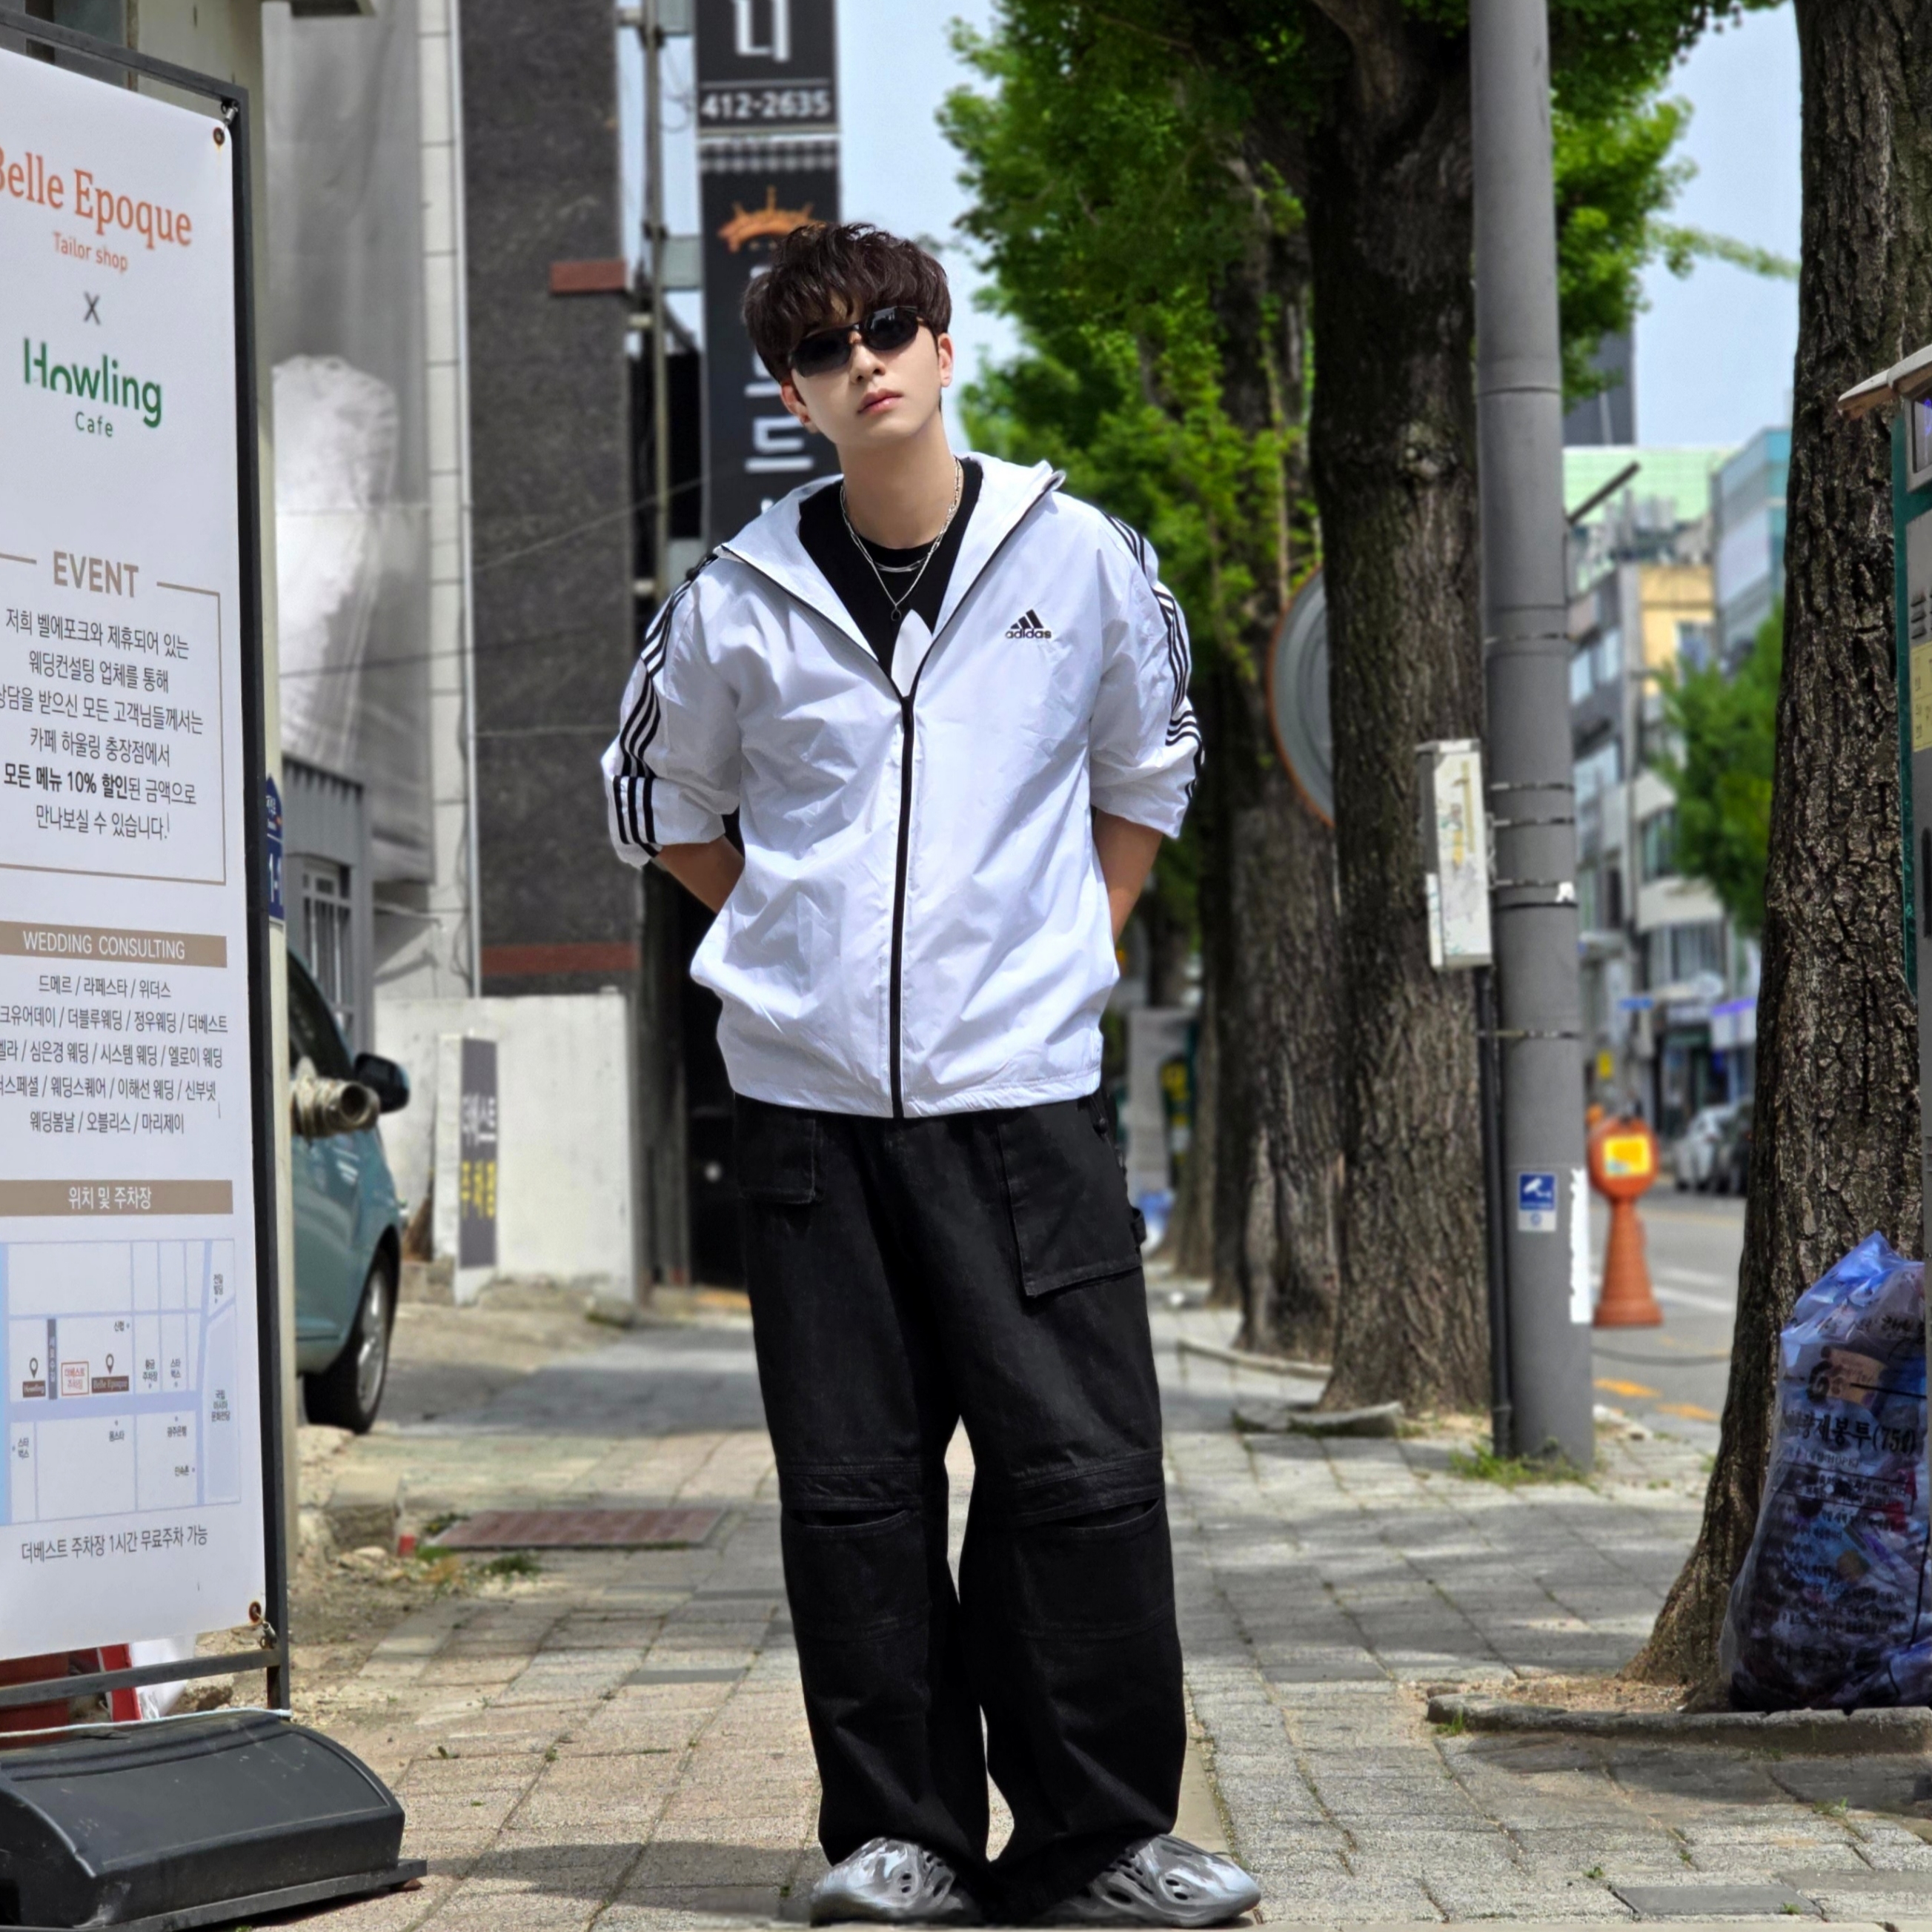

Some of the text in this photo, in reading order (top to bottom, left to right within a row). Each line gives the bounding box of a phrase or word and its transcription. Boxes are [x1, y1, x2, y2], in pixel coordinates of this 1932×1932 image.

[73, 168, 193, 249] Epoque
[53, 232, 128, 274] Tailor shop
[23, 338, 162, 428] Howling
[76, 412, 113, 437] Cafe
[53, 551, 139, 597] EVENT
[6, 608, 189, 660] 저희 벨에포크와 제휴되어 있는
[1005, 628, 1052, 639] adidas
[29, 650, 169, 693] 웨딩컨설팅 업체를 통해
[39, 690, 78, 718] 받으신
[83, 697, 109, 722] 모든
[113, 701, 204, 734] 고객님들께서는
[30, 728, 169, 767] 카페 하울링 충장점에서
[4, 763, 196, 805] 모든 메뉴 10% 할인된 금액으로
[36, 804, 89, 834] 만나보실
[93, 811, 107, 834] 수
[23, 931, 185, 960] WEDDING CONSULTING
[39, 975, 73, 994] 드메르
[84, 977, 127, 998] 라페스타
[139, 979, 171, 999] 위더스
[0, 1005, 56, 1028] 크유어데이
[68, 1008, 122, 1031] 더블루웨딩
[134, 1011, 176, 1033] 정우웨딩
[188, 1013, 228, 1034] 더베스트
[30, 1040, 63, 1063] 심은경
[67, 1041, 88, 1064] 웨딩
[101, 1043, 133, 1065] 시스템
[136, 1044, 157, 1066] 웨딩
[169, 1046, 200, 1068] 엘로이
[203, 1047, 222, 1069] 웨딩
[0, 1075, 39, 1097] 스페셜
[51, 1076, 106, 1099] 웨딩스퀘어
[119, 1078, 150, 1100] 이해선
[153, 1079, 173, 1101] 웨딩
[185, 1080, 216, 1101] 신부넷
[30, 1111, 75, 1133] 웨딩봄날
[87, 1112, 130, 1133] 오블리스
[142, 1113, 185, 1135] 마리제이
[68, 1186, 152, 1209] 위치 및 주차장
[21, 1524, 208, 1564] 더베스트 주차장 1시간 무료주차 가능
